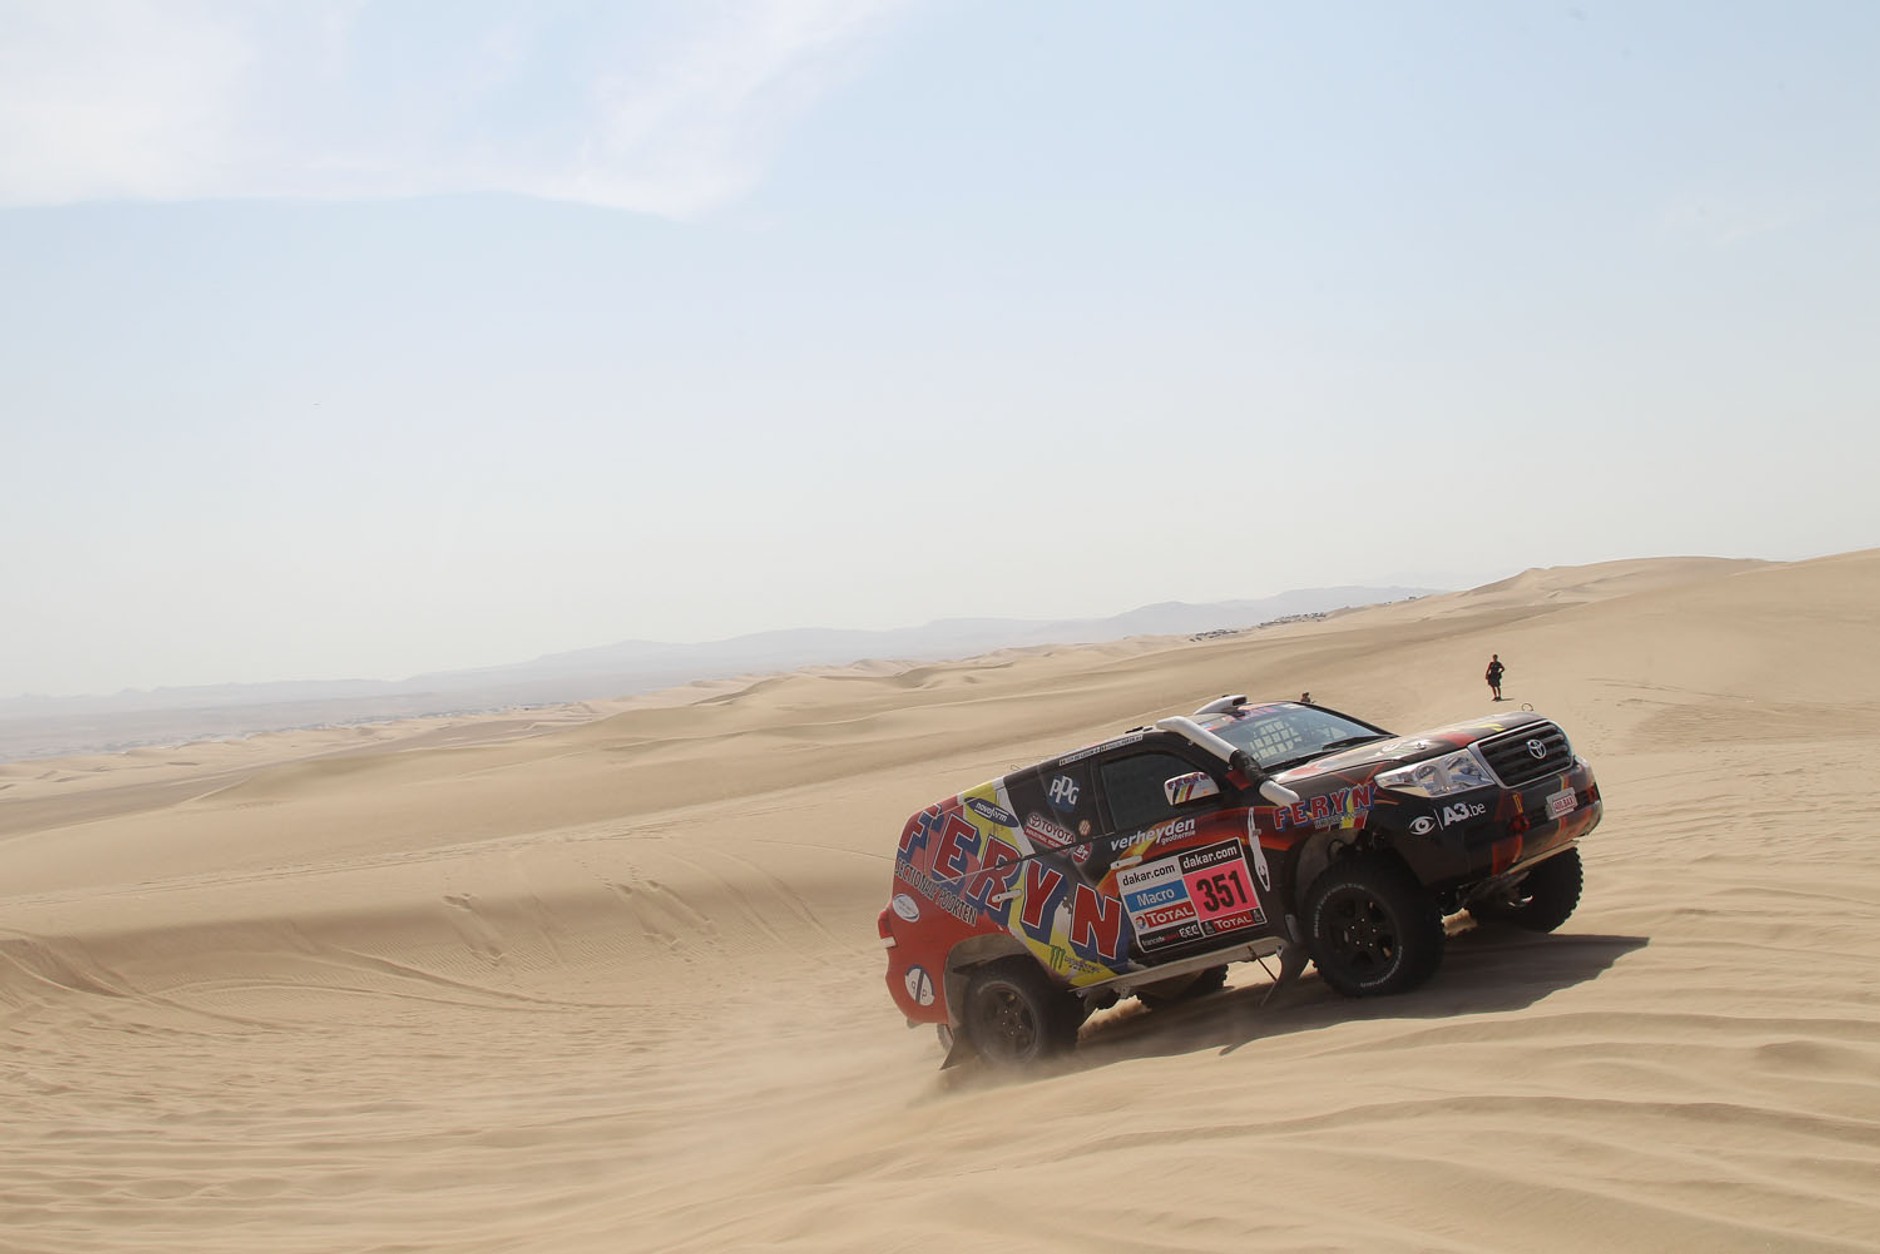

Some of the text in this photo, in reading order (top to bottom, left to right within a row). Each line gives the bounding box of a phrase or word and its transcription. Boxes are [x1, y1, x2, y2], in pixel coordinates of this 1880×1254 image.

[975, 802, 1008, 822] novoform
[1273, 783, 1371, 830] FERYN
[1443, 802, 1486, 826] A3.be
[1041, 821, 1075, 844] TOYOTA
[1110, 818, 1195, 851] verheyden
[1183, 845, 1238, 869] dakar.com
[898, 803, 1122, 961] FERYN
[1122, 864, 1176, 886] dakar.com
[1136, 888, 1175, 907] Macro
[1196, 869, 1248, 913] 351
[937, 886, 978, 928] POORTEN
[1146, 907, 1194, 925] TOTAL
[1216, 914, 1252, 930] TOTAL
